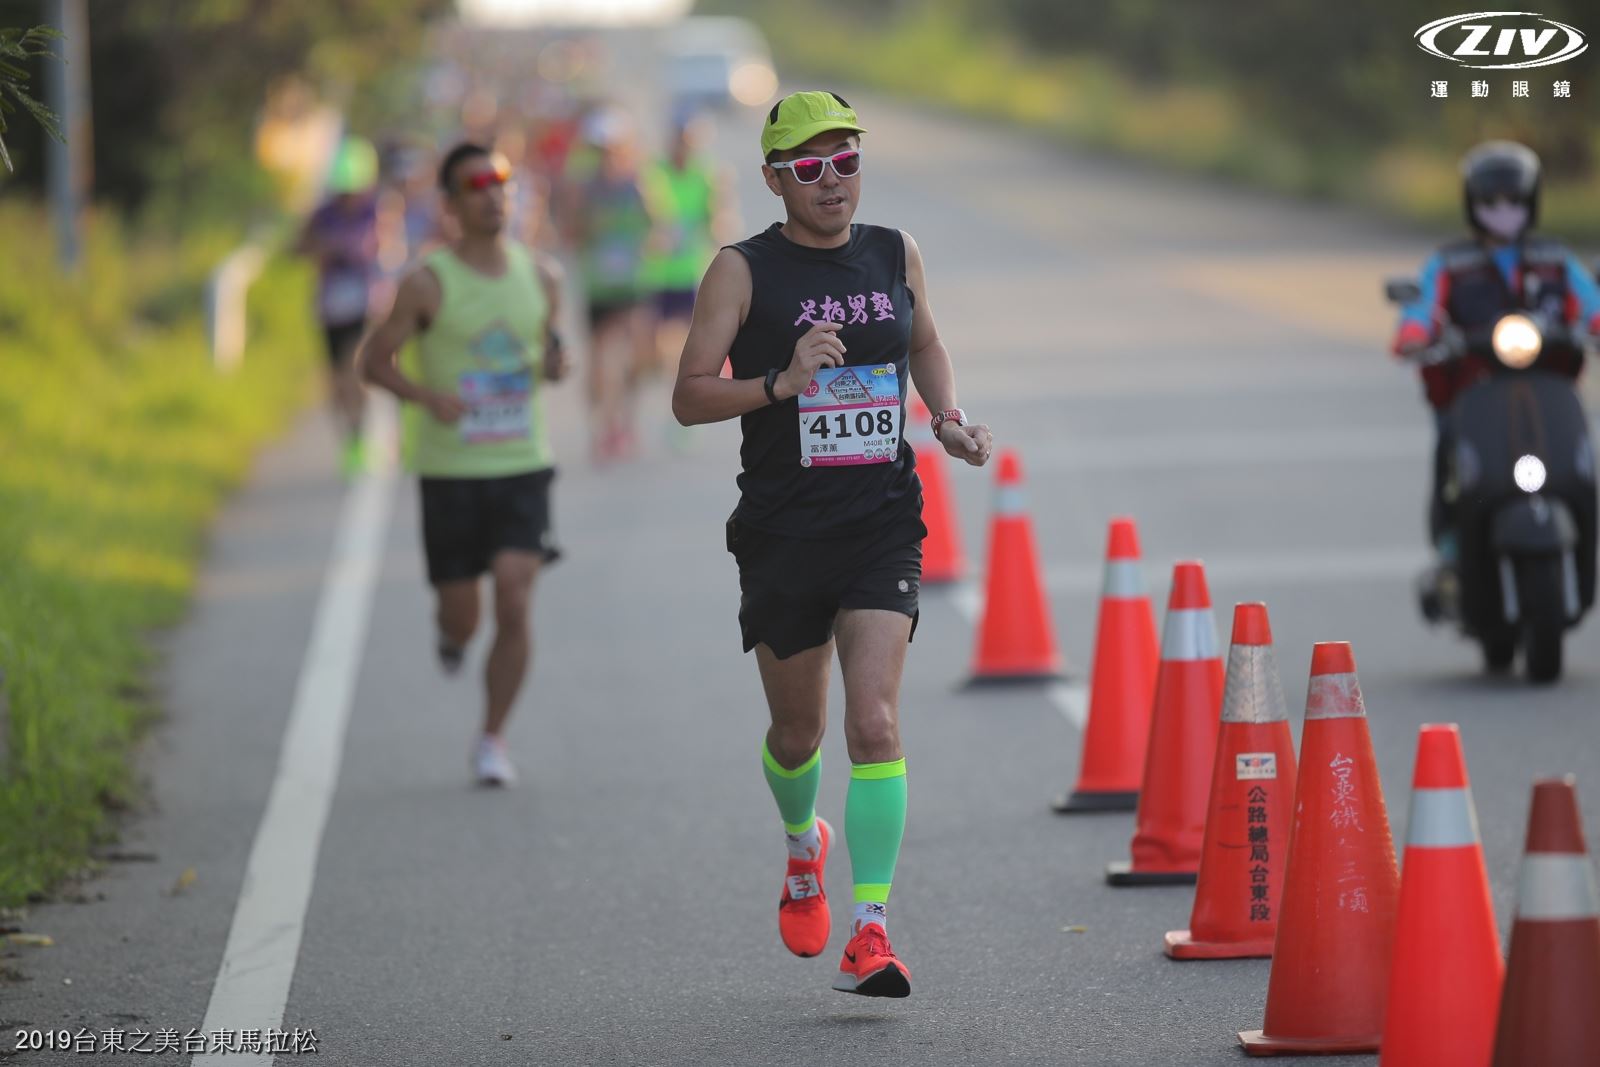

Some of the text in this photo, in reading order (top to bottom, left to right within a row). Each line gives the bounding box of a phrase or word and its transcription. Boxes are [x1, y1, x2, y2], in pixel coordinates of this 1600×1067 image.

[809, 409, 893, 439] 4108
[1247, 785, 1271, 922] 公路總局台東段
